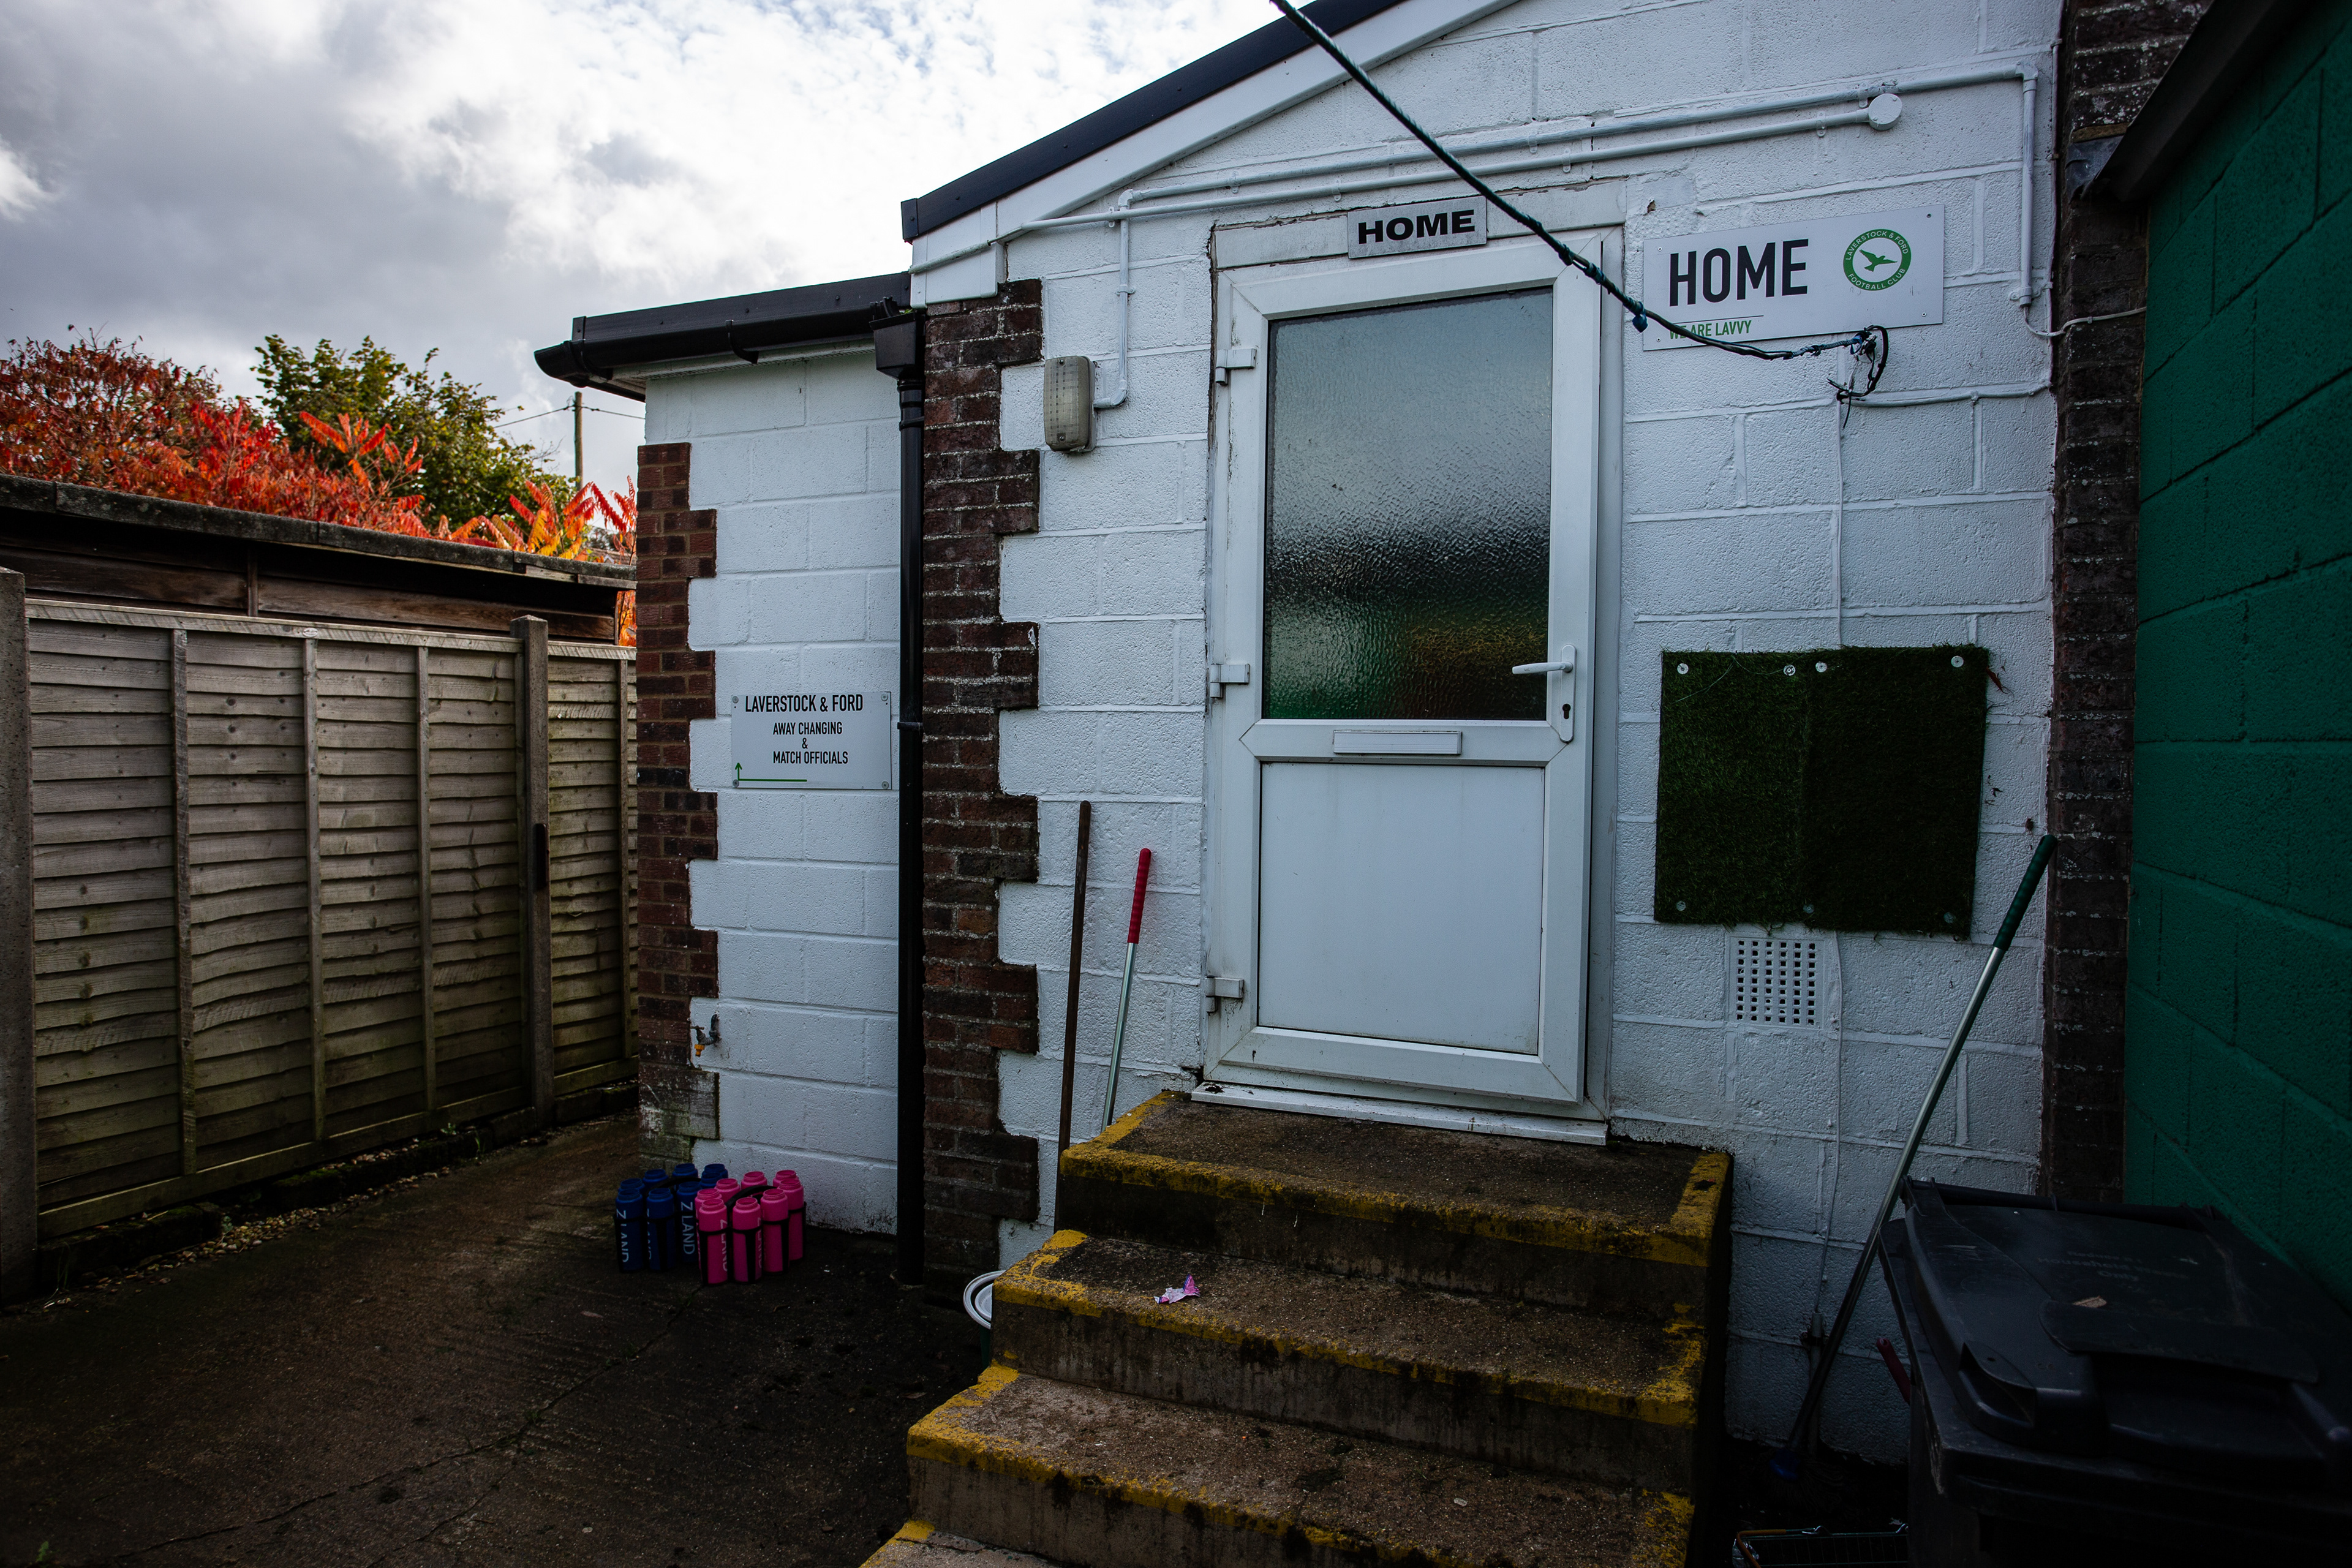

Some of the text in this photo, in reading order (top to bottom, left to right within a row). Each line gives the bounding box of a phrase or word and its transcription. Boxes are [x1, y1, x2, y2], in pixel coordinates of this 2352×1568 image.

[1358, 209, 1476, 244] HOME
[1845, 230, 1888, 260] LAVERSTOCK
[1894, 236, 1909, 254] FORD
[1669, 238, 1809, 307] HOME
[1848, 268, 1905, 290] FOOTBALL CLUB
[1691, 323, 1713, 337] ARE
[1716, 320, 1752, 336] LAVVY
[745, 694, 863, 712] LAVERSTOCK & FORD
[773, 722, 842, 735] AWAY CHANGING
[802, 737, 808, 749] &
[773, 751, 848, 764] MATCH OFFICIALS
